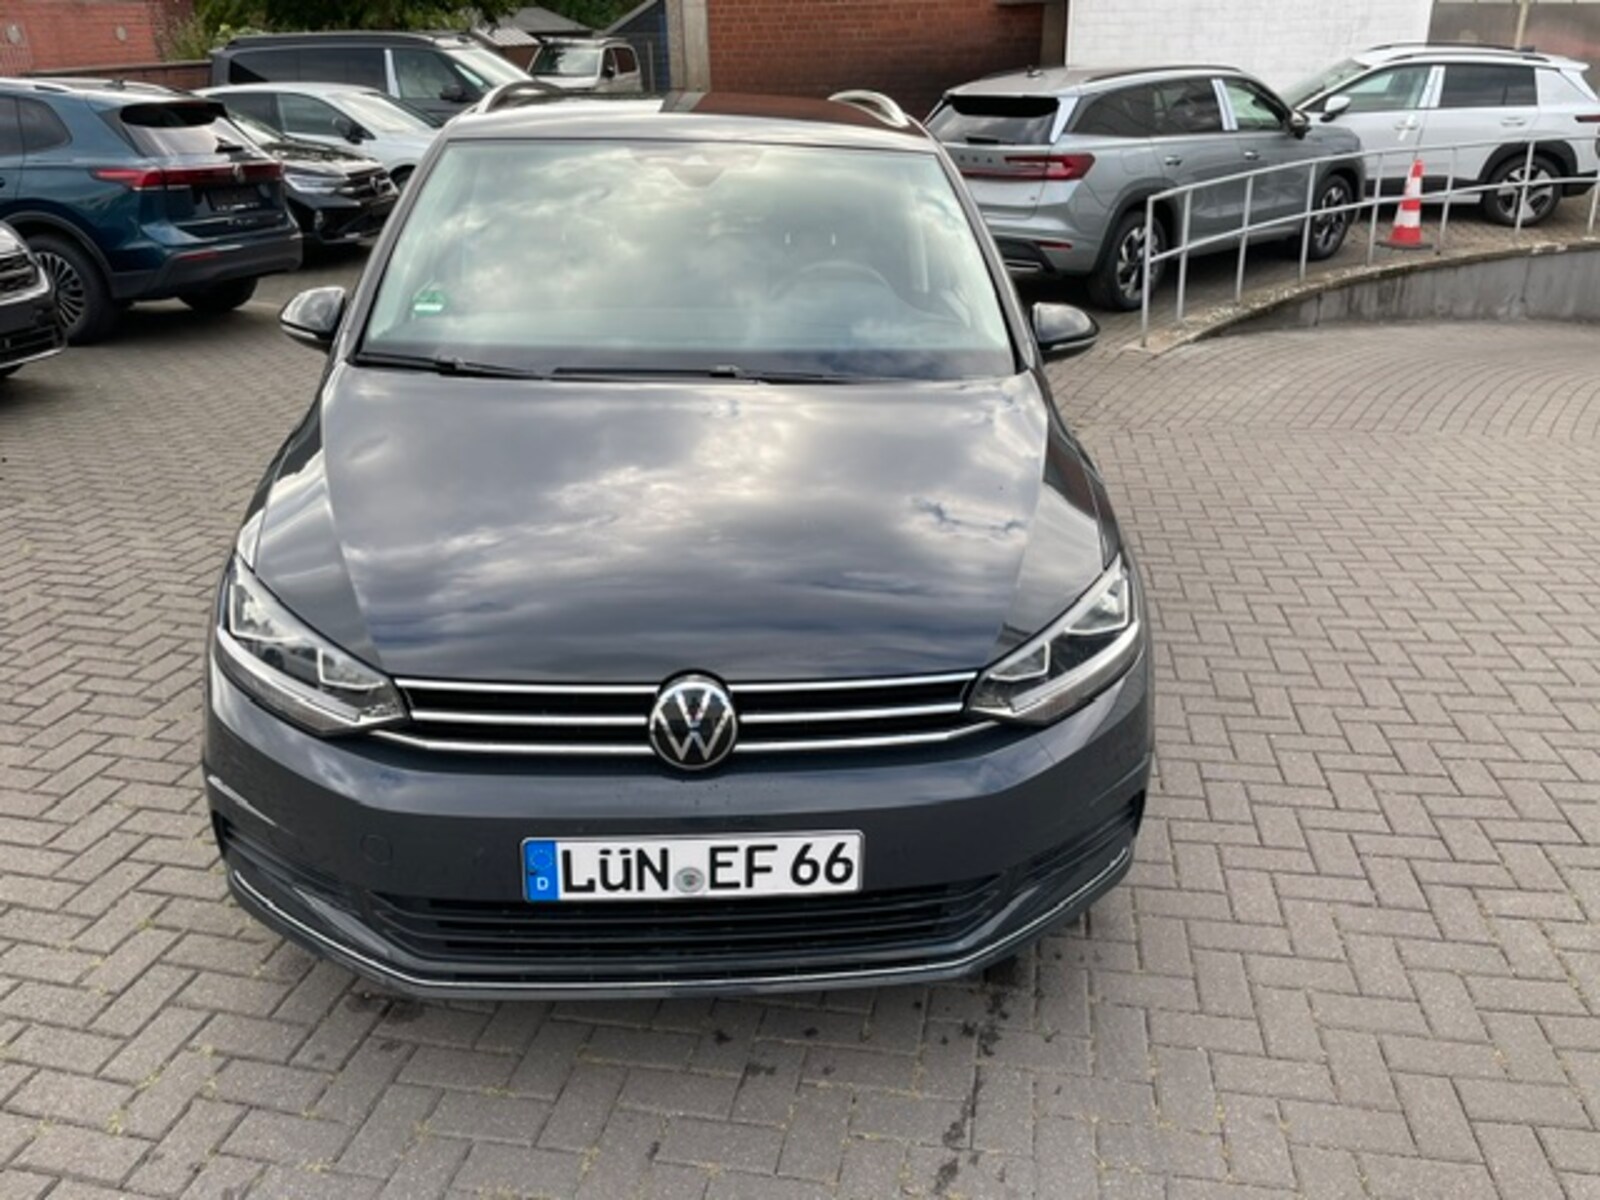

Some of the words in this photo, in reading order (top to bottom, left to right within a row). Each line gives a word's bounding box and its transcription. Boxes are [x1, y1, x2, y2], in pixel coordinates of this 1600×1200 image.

[652, 682, 736, 765] VW
[537, 876, 549, 891] D
[708, 845, 778, 889] EF
[790, 842, 854, 886] 66
